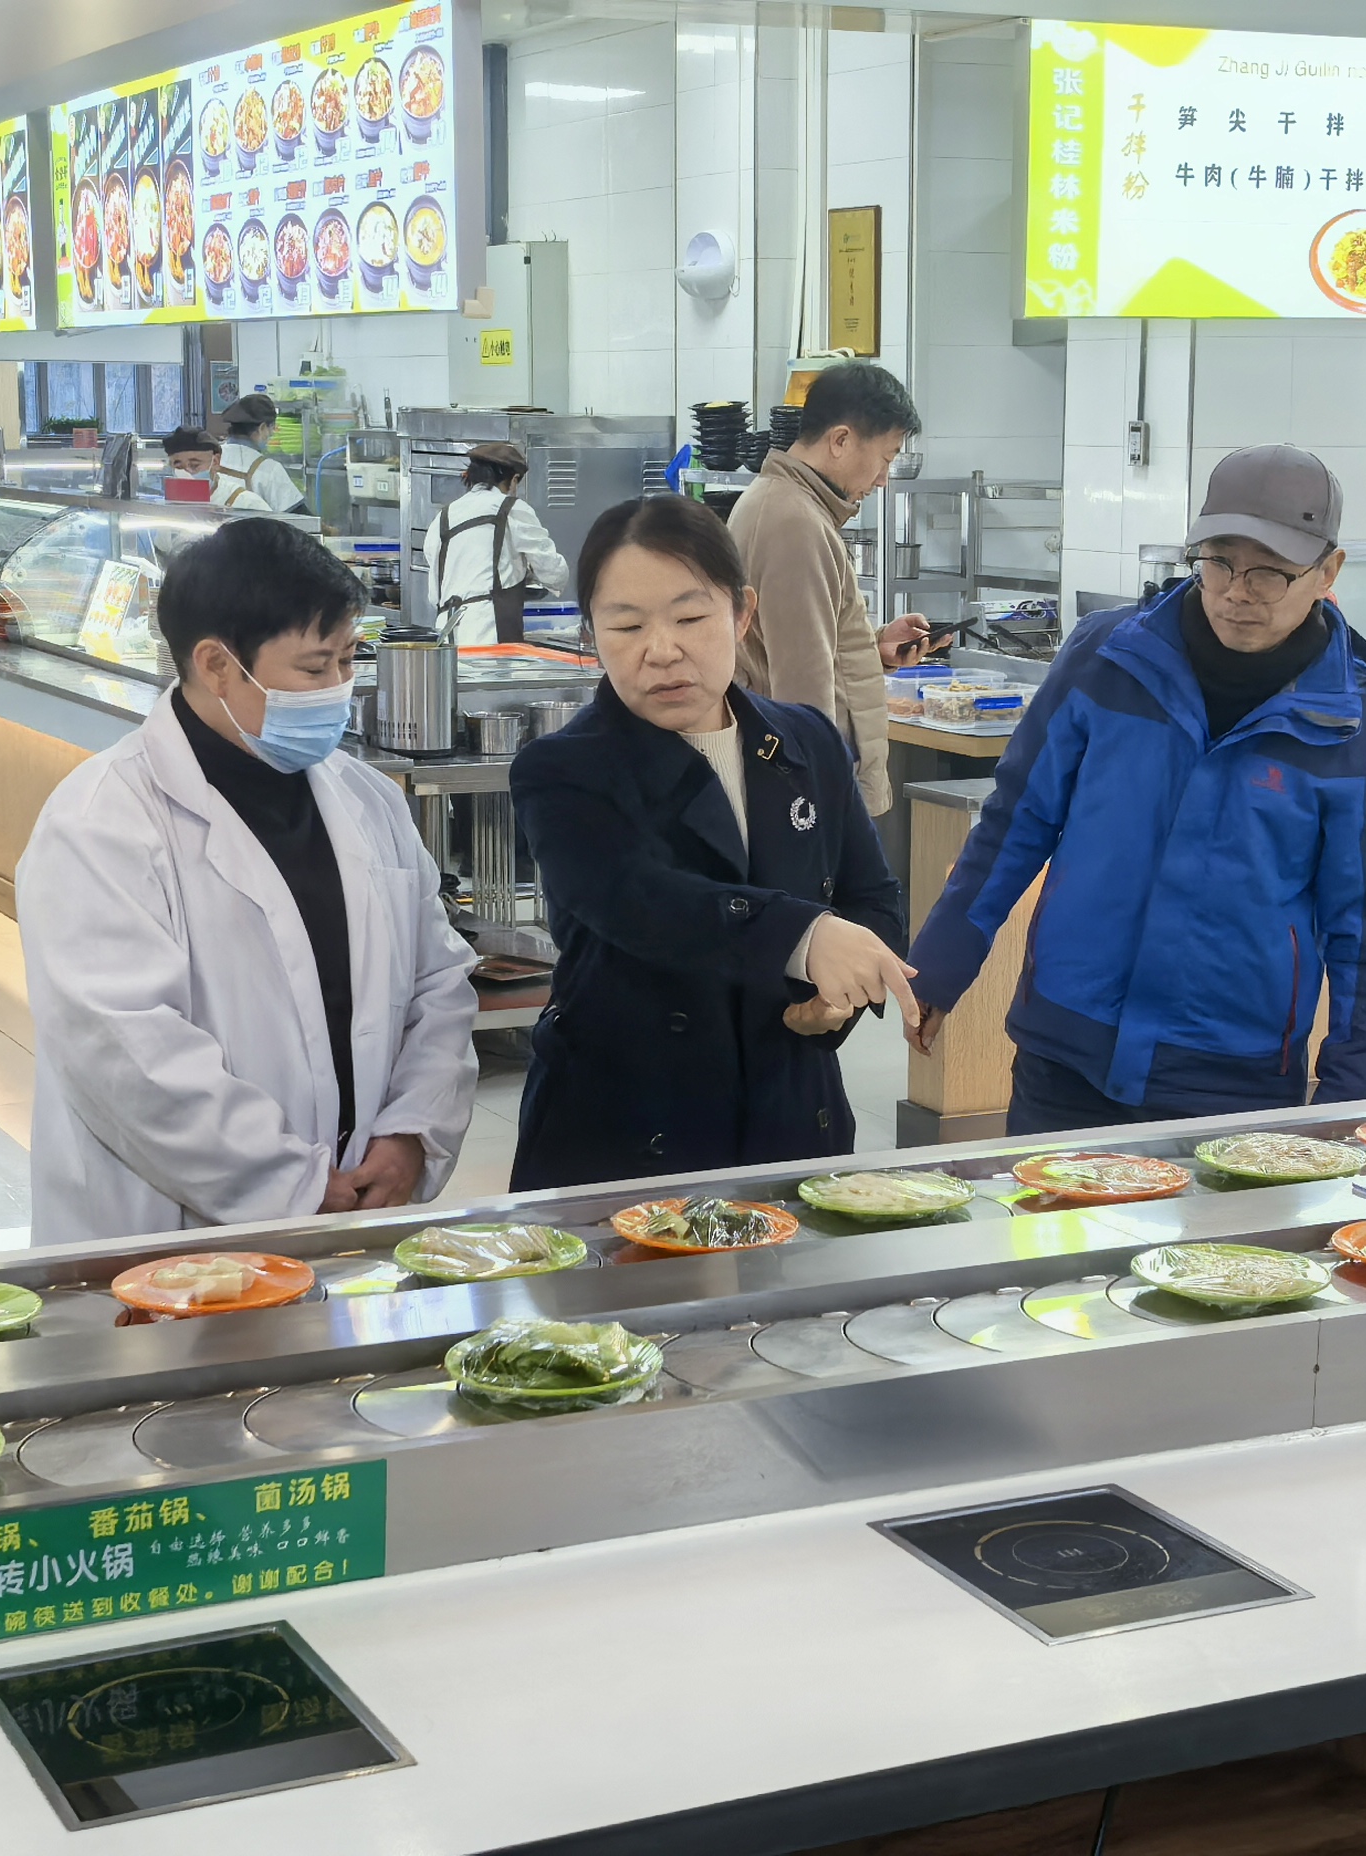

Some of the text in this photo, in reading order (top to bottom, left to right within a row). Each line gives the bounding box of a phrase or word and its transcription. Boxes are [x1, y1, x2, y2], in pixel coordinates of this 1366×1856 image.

[1217, 56, 1270, 79] Zhang
[1047, 67, 1085, 271] 张记桂林米粉
[1121, 92, 1150, 201] 干拌粉
[87, 1493, 208, 1541] 番茄锅、
[253, 1470, 353, 1513] 菌汤锅
